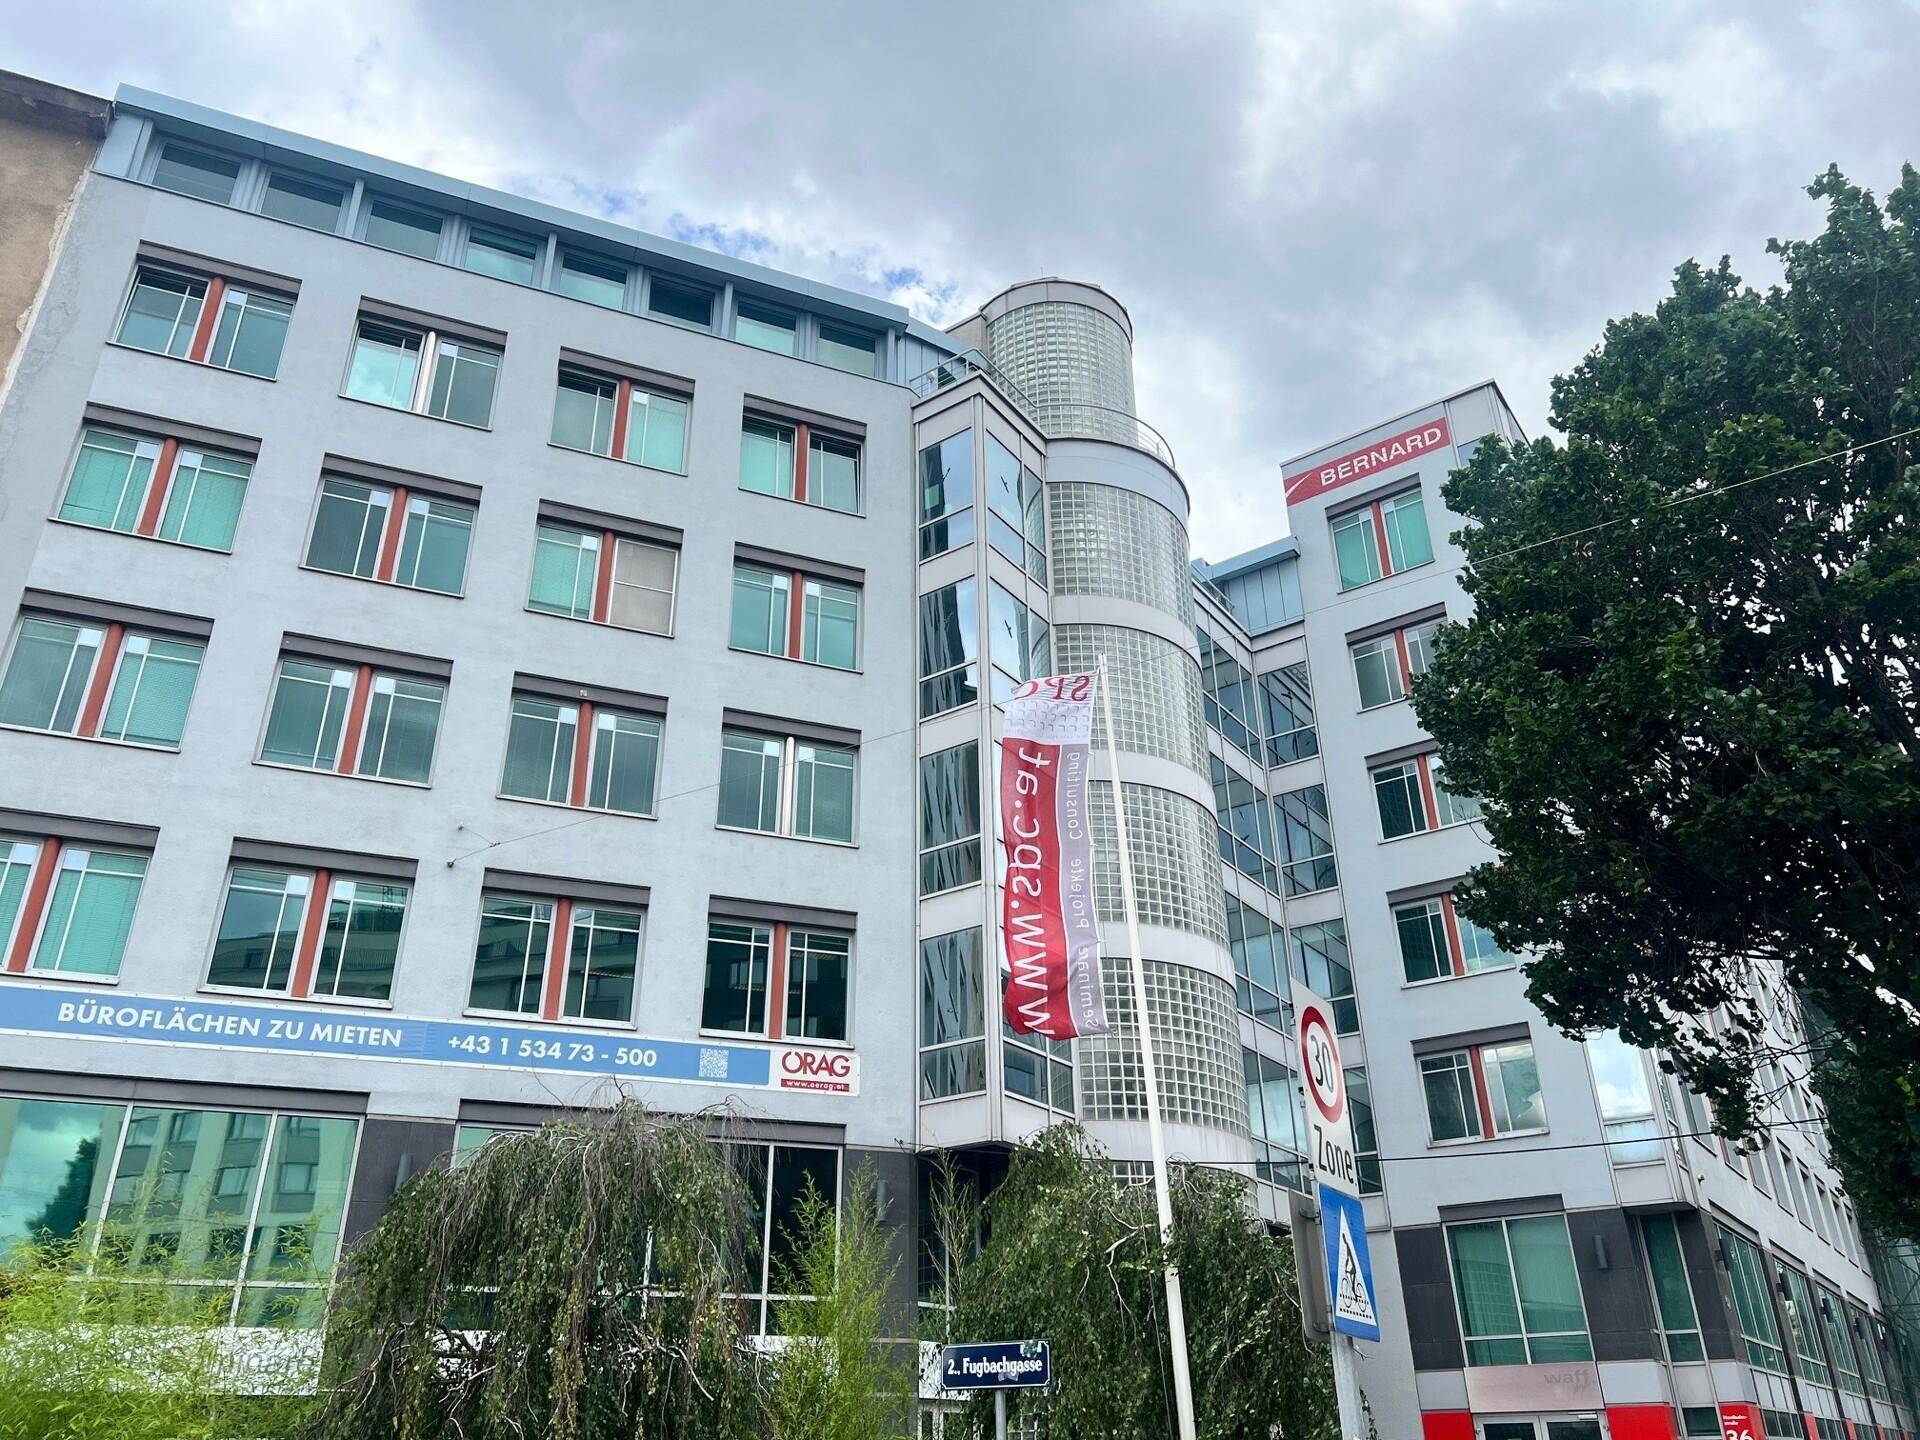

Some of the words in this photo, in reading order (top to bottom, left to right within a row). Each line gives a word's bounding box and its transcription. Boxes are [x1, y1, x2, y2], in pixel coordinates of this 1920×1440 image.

[1320, 427, 1442, 486] BERNARD
[57, 999, 260, 1036] BÜROFLÄCHEN
[265, 1019, 304, 1040] ZU
[309, 1024, 402, 1047] MIETEN
[448, 1035, 491, 1053] +43
[500, 1038, 509, 1055] 1
[517, 1039, 562, 1062] 534
[566, 1043, 595, 1062] 73
[613, 1047, 658, 1067] 500
[1310, 1034, 1334, 1094] 30
[1313, 1125, 1354, 1185] Zone
[962, 1356, 1043, 1377] Fugbachgasse
